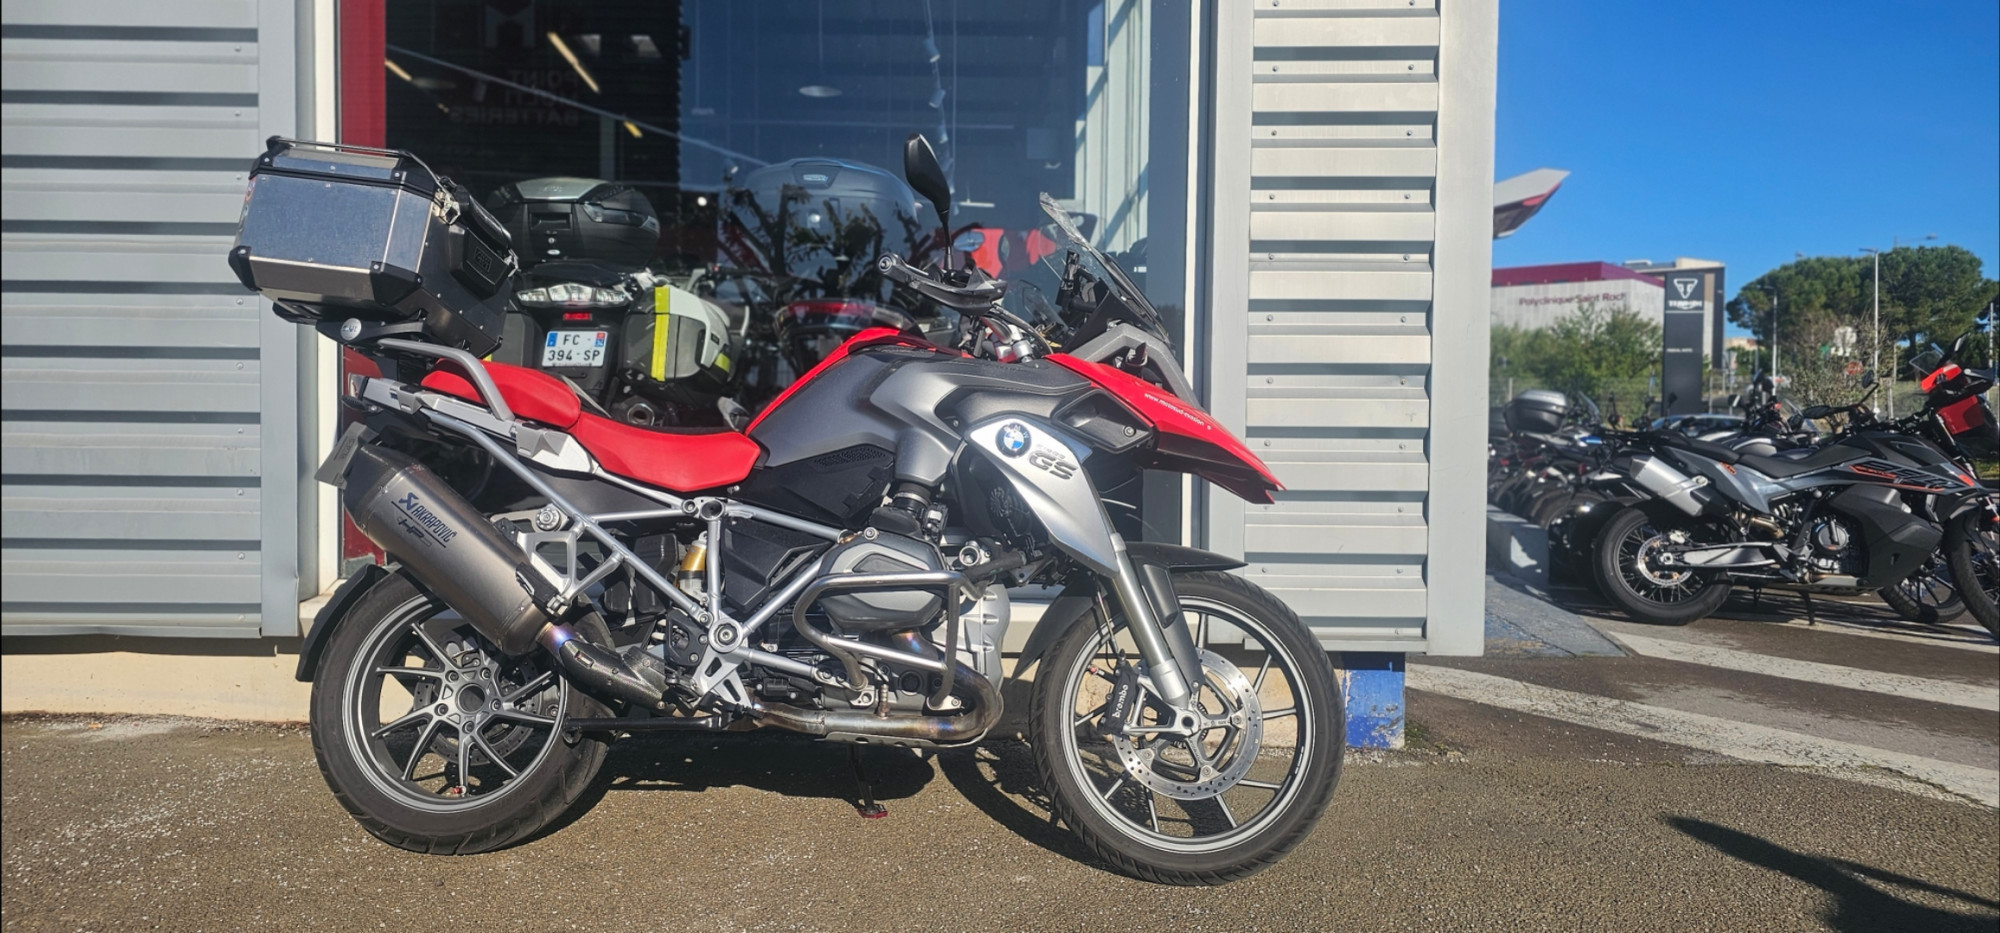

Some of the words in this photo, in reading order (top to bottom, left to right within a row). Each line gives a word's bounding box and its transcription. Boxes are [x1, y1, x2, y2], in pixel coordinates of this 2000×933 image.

[1519, 296, 1573, 306] Polyclinique
[1576, 294, 1600, 303] Saint
[1029, 450, 1078, 480] GS
[1111, 684, 1128, 718] brembo
